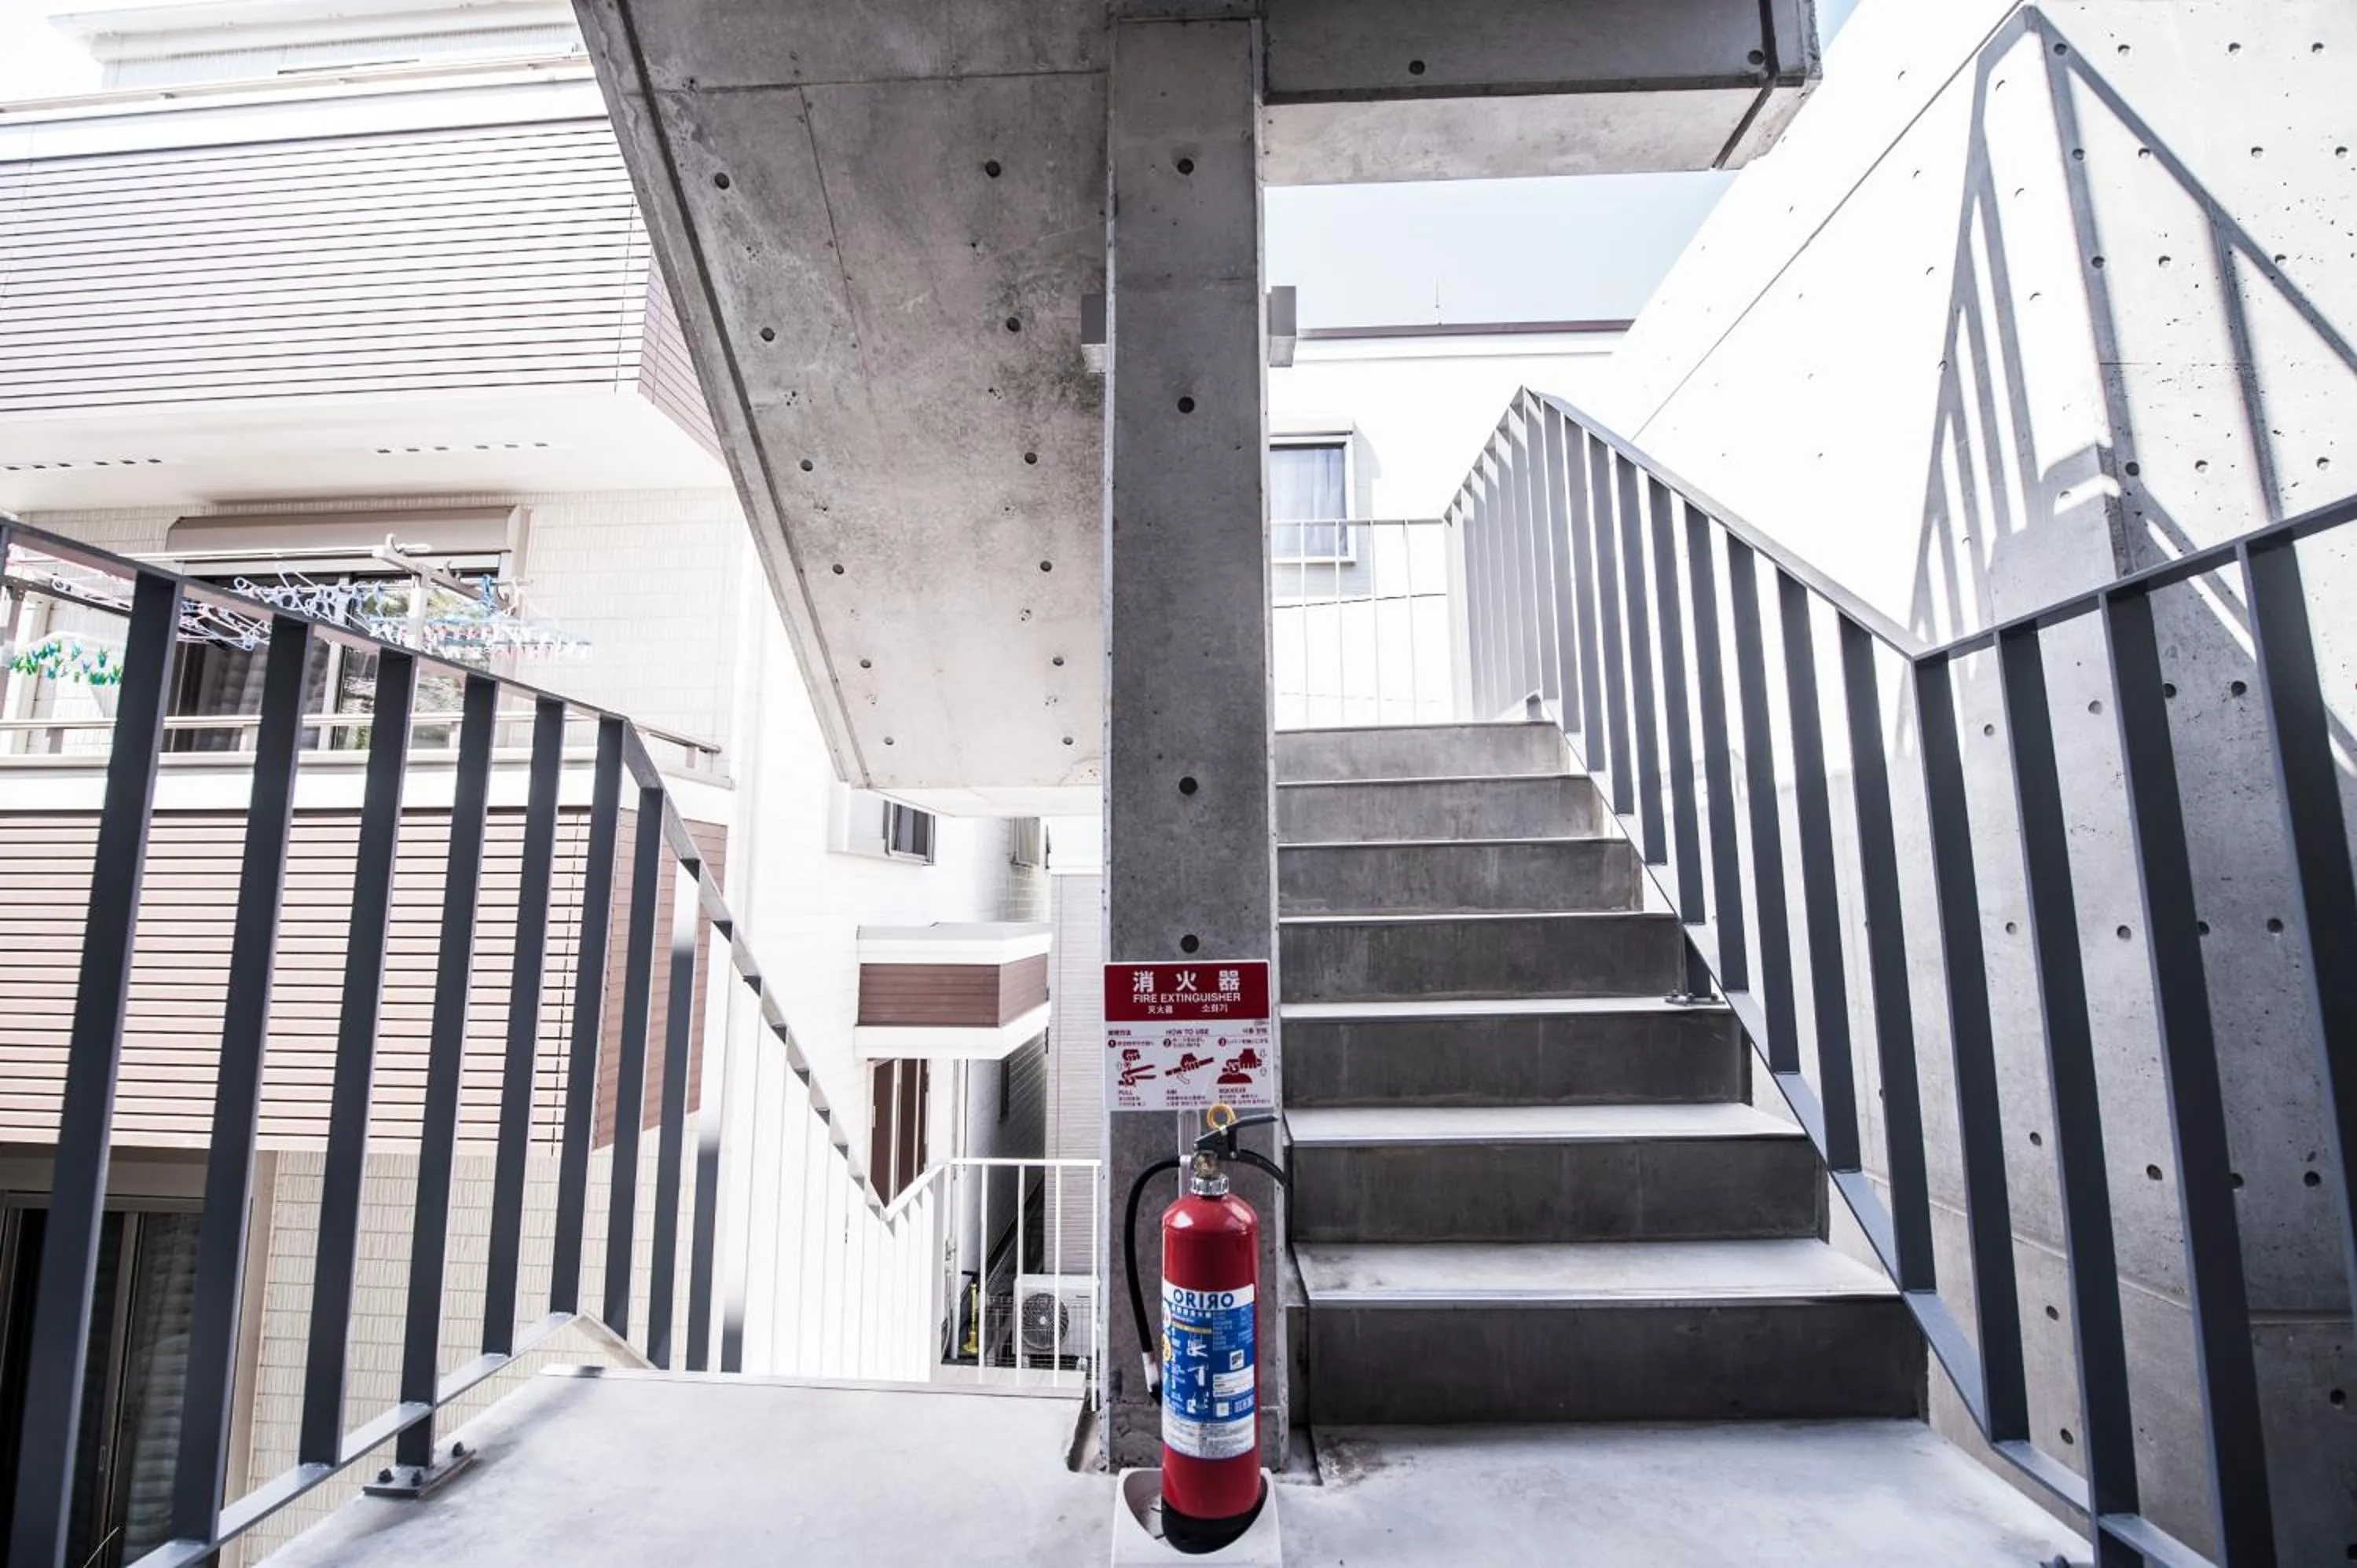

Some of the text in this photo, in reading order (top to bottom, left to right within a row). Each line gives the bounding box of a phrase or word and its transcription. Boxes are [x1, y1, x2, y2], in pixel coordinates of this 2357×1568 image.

[1132, 969, 1241, 993] 消火器
[1132, 992, 1241, 1003] FIRE EXTINGUISHER
